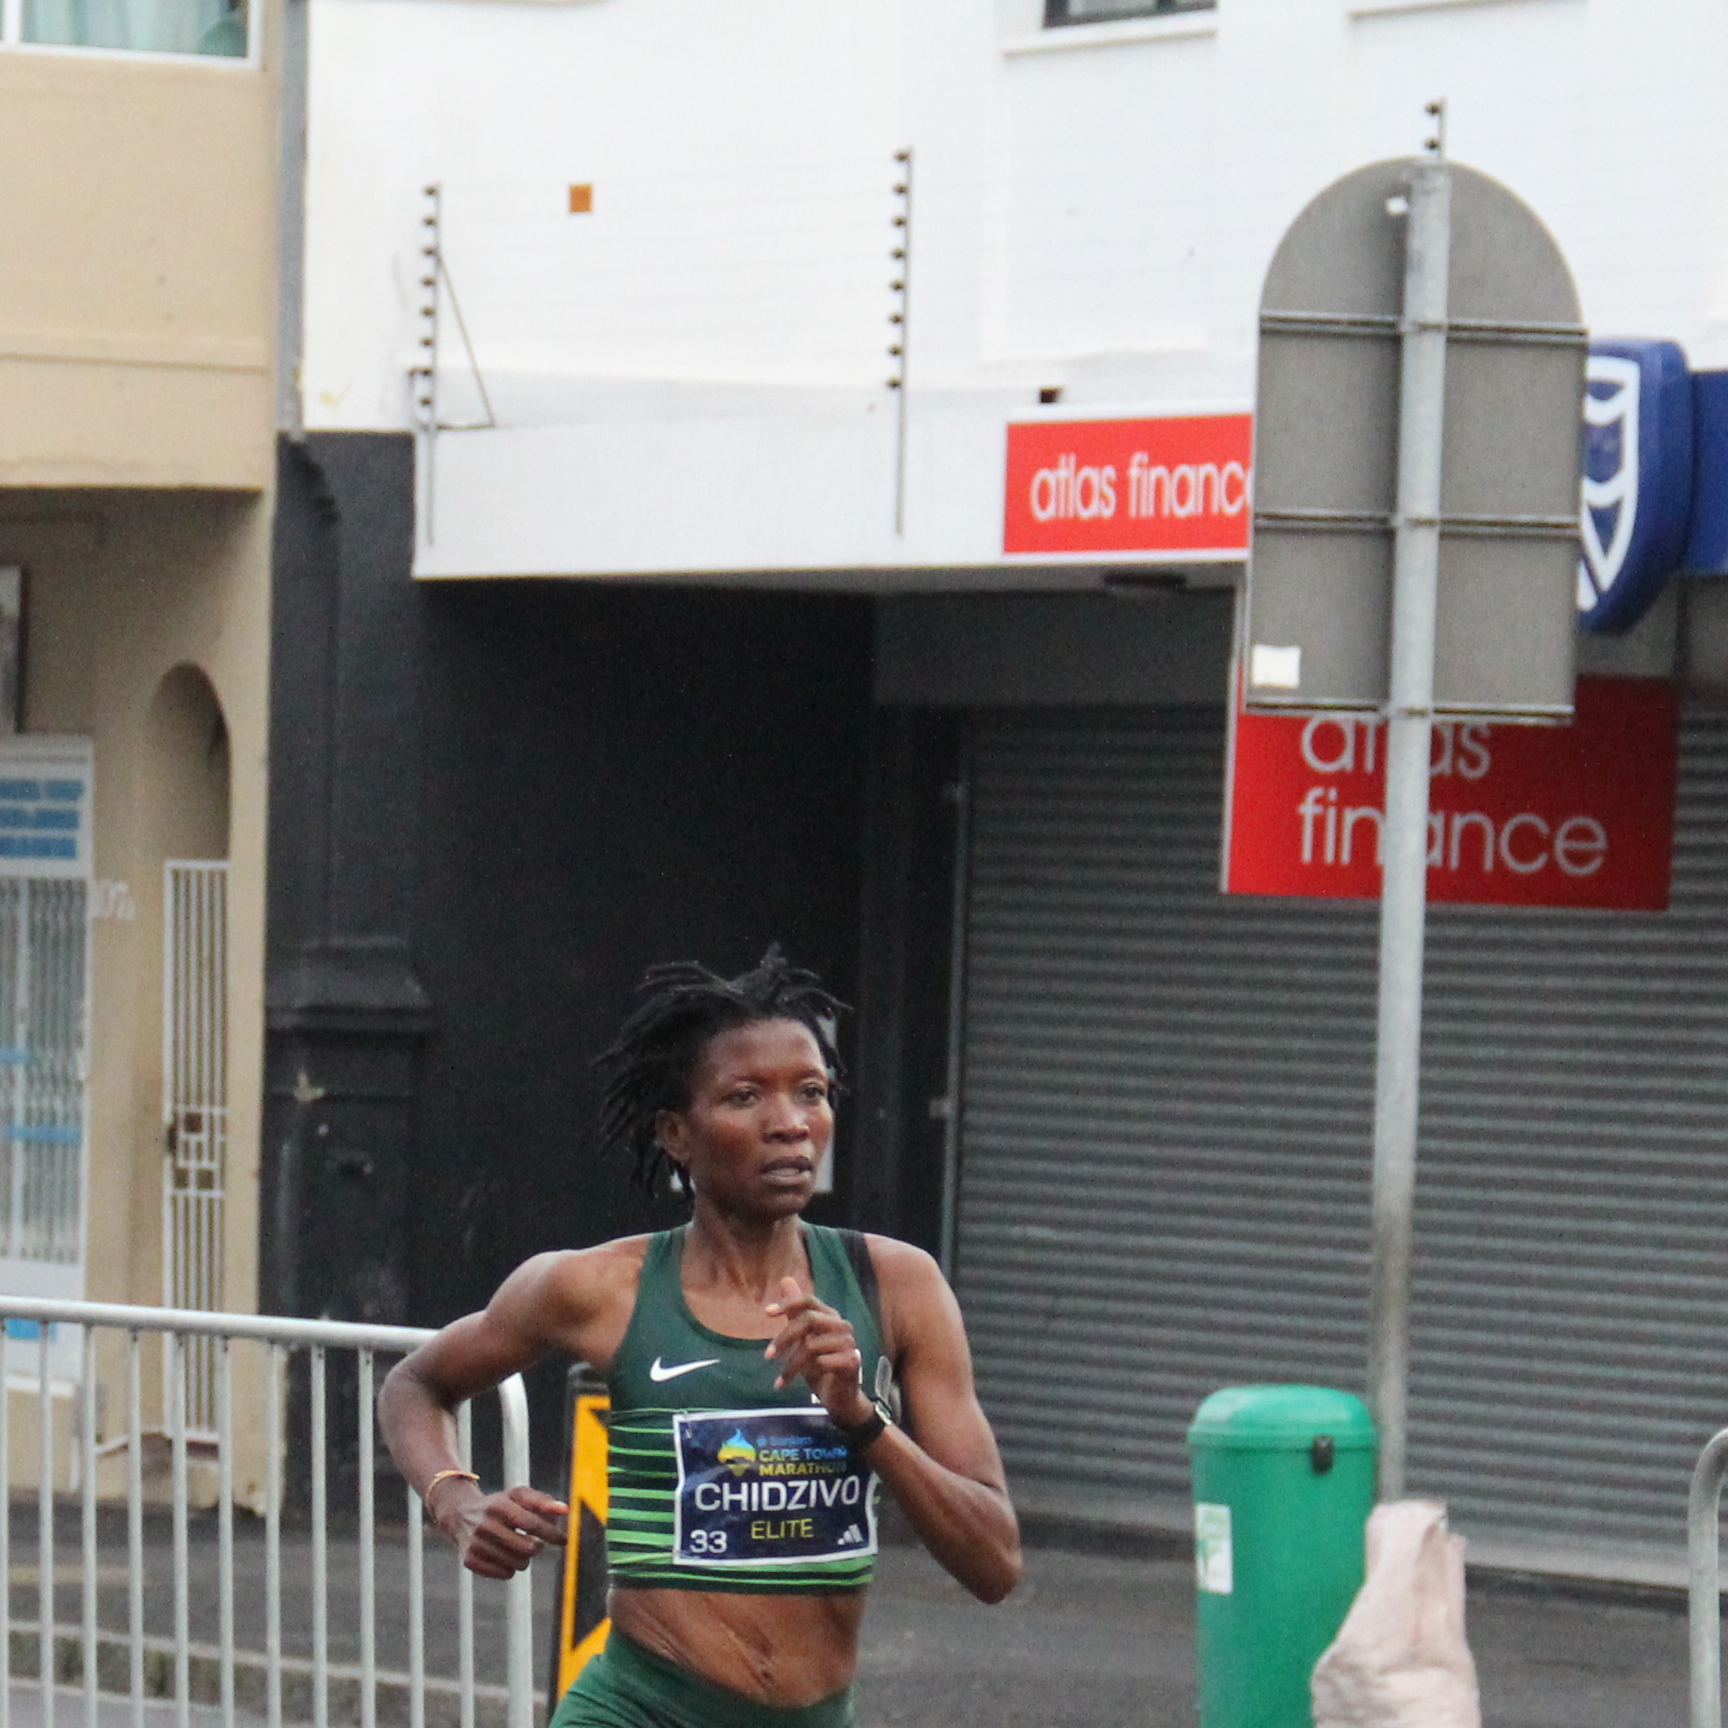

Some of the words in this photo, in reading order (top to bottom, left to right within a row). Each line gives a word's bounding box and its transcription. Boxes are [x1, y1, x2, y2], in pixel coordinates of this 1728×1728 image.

[1030, 452, 1117, 522] atlas
[1129, 451, 1255, 519] financ
[1299, 713, 1493, 780] ats
[759, 1449, 800, 1463] CAPE
[805, 1447, 849, 1461] TOWN
[759, 1462, 848, 1476] MARATHON
[694, 1475, 861, 1512] CHIDZIVO
[689, 1529, 728, 1554] 33
[751, 1518, 815, 1540] ELITE
